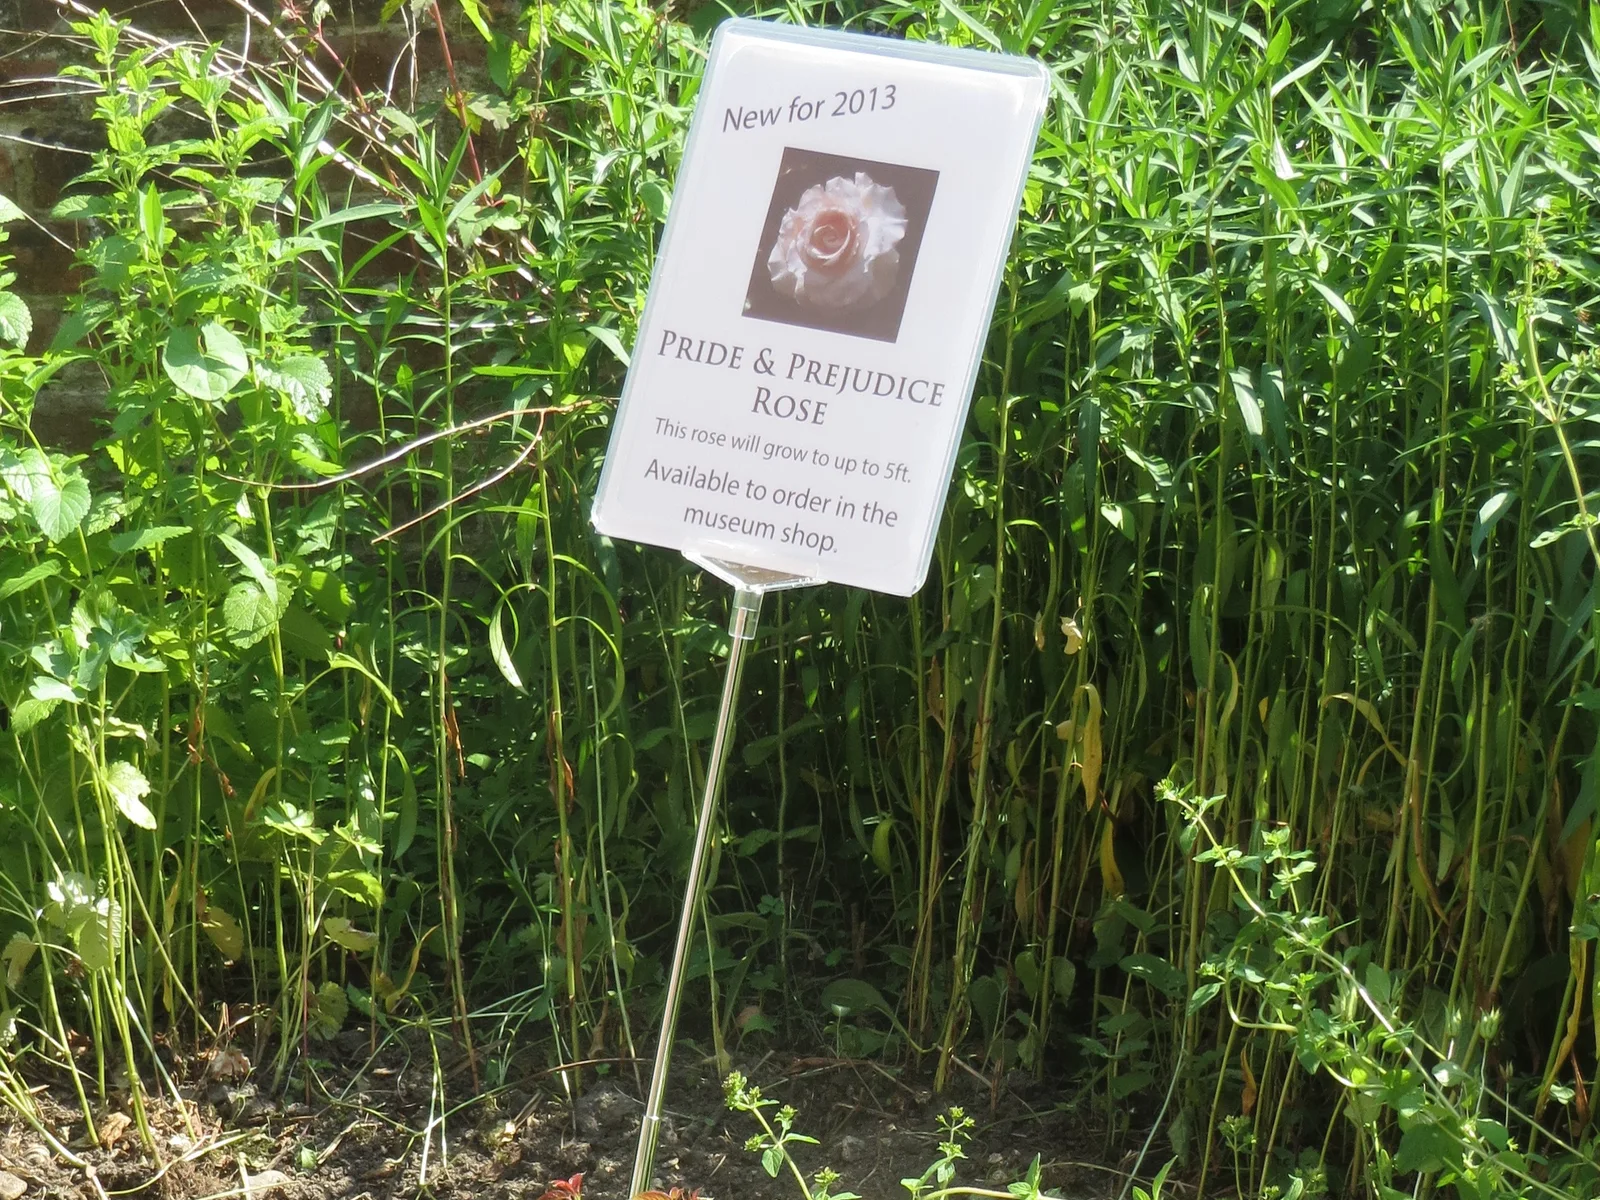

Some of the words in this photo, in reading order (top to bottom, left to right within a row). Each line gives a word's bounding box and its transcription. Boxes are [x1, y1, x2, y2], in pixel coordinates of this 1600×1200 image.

[722, 103, 781, 133] New
[788, 95, 825, 124] for
[831, 84, 896, 117] 2013
[657, 329, 744, 370] PRIDE
[753, 348, 776, 377] &
[786, 352, 945, 407] PREJUDICE
[751, 386, 828, 425] ROSE
[655, 417, 687, 439] This
[691, 427, 727, 447] rose
[731, 432, 761, 454] will
[763, 439, 808, 461] grow
[812, 449, 829, 467] to
[834, 455, 857, 475] up
[862, 458, 879, 476] to
[884, 460, 911, 483] 5ft.
[644, 458, 740, 495] Available
[746, 478, 767, 501] to
[772, 487, 832, 514] order
[835, 495, 856, 519] in
[862, 501, 898, 528] the
[683, 506, 776, 539] museum
[780, 521, 838, 556] shop.
